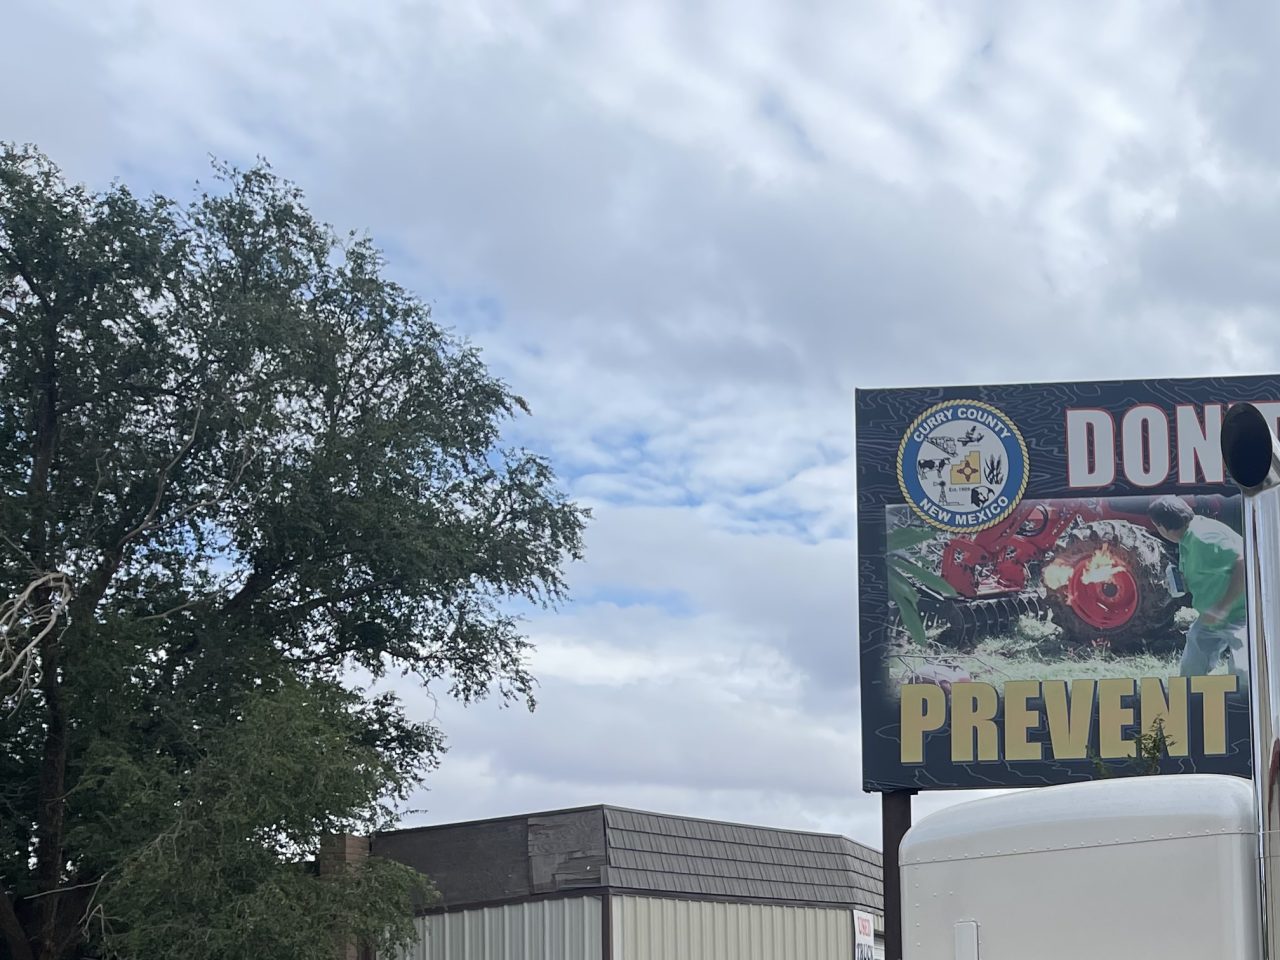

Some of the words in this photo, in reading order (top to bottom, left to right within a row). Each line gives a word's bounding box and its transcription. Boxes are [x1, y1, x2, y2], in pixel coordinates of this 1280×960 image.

[913, 408, 953, 443] CURRY
[957, 407, 1012, 440] COUNTY
[919, 497, 952, 523] NEW
[955, 495, 1009, 526] MEXICO
[900, 674, 1238, 764] PREVENT
